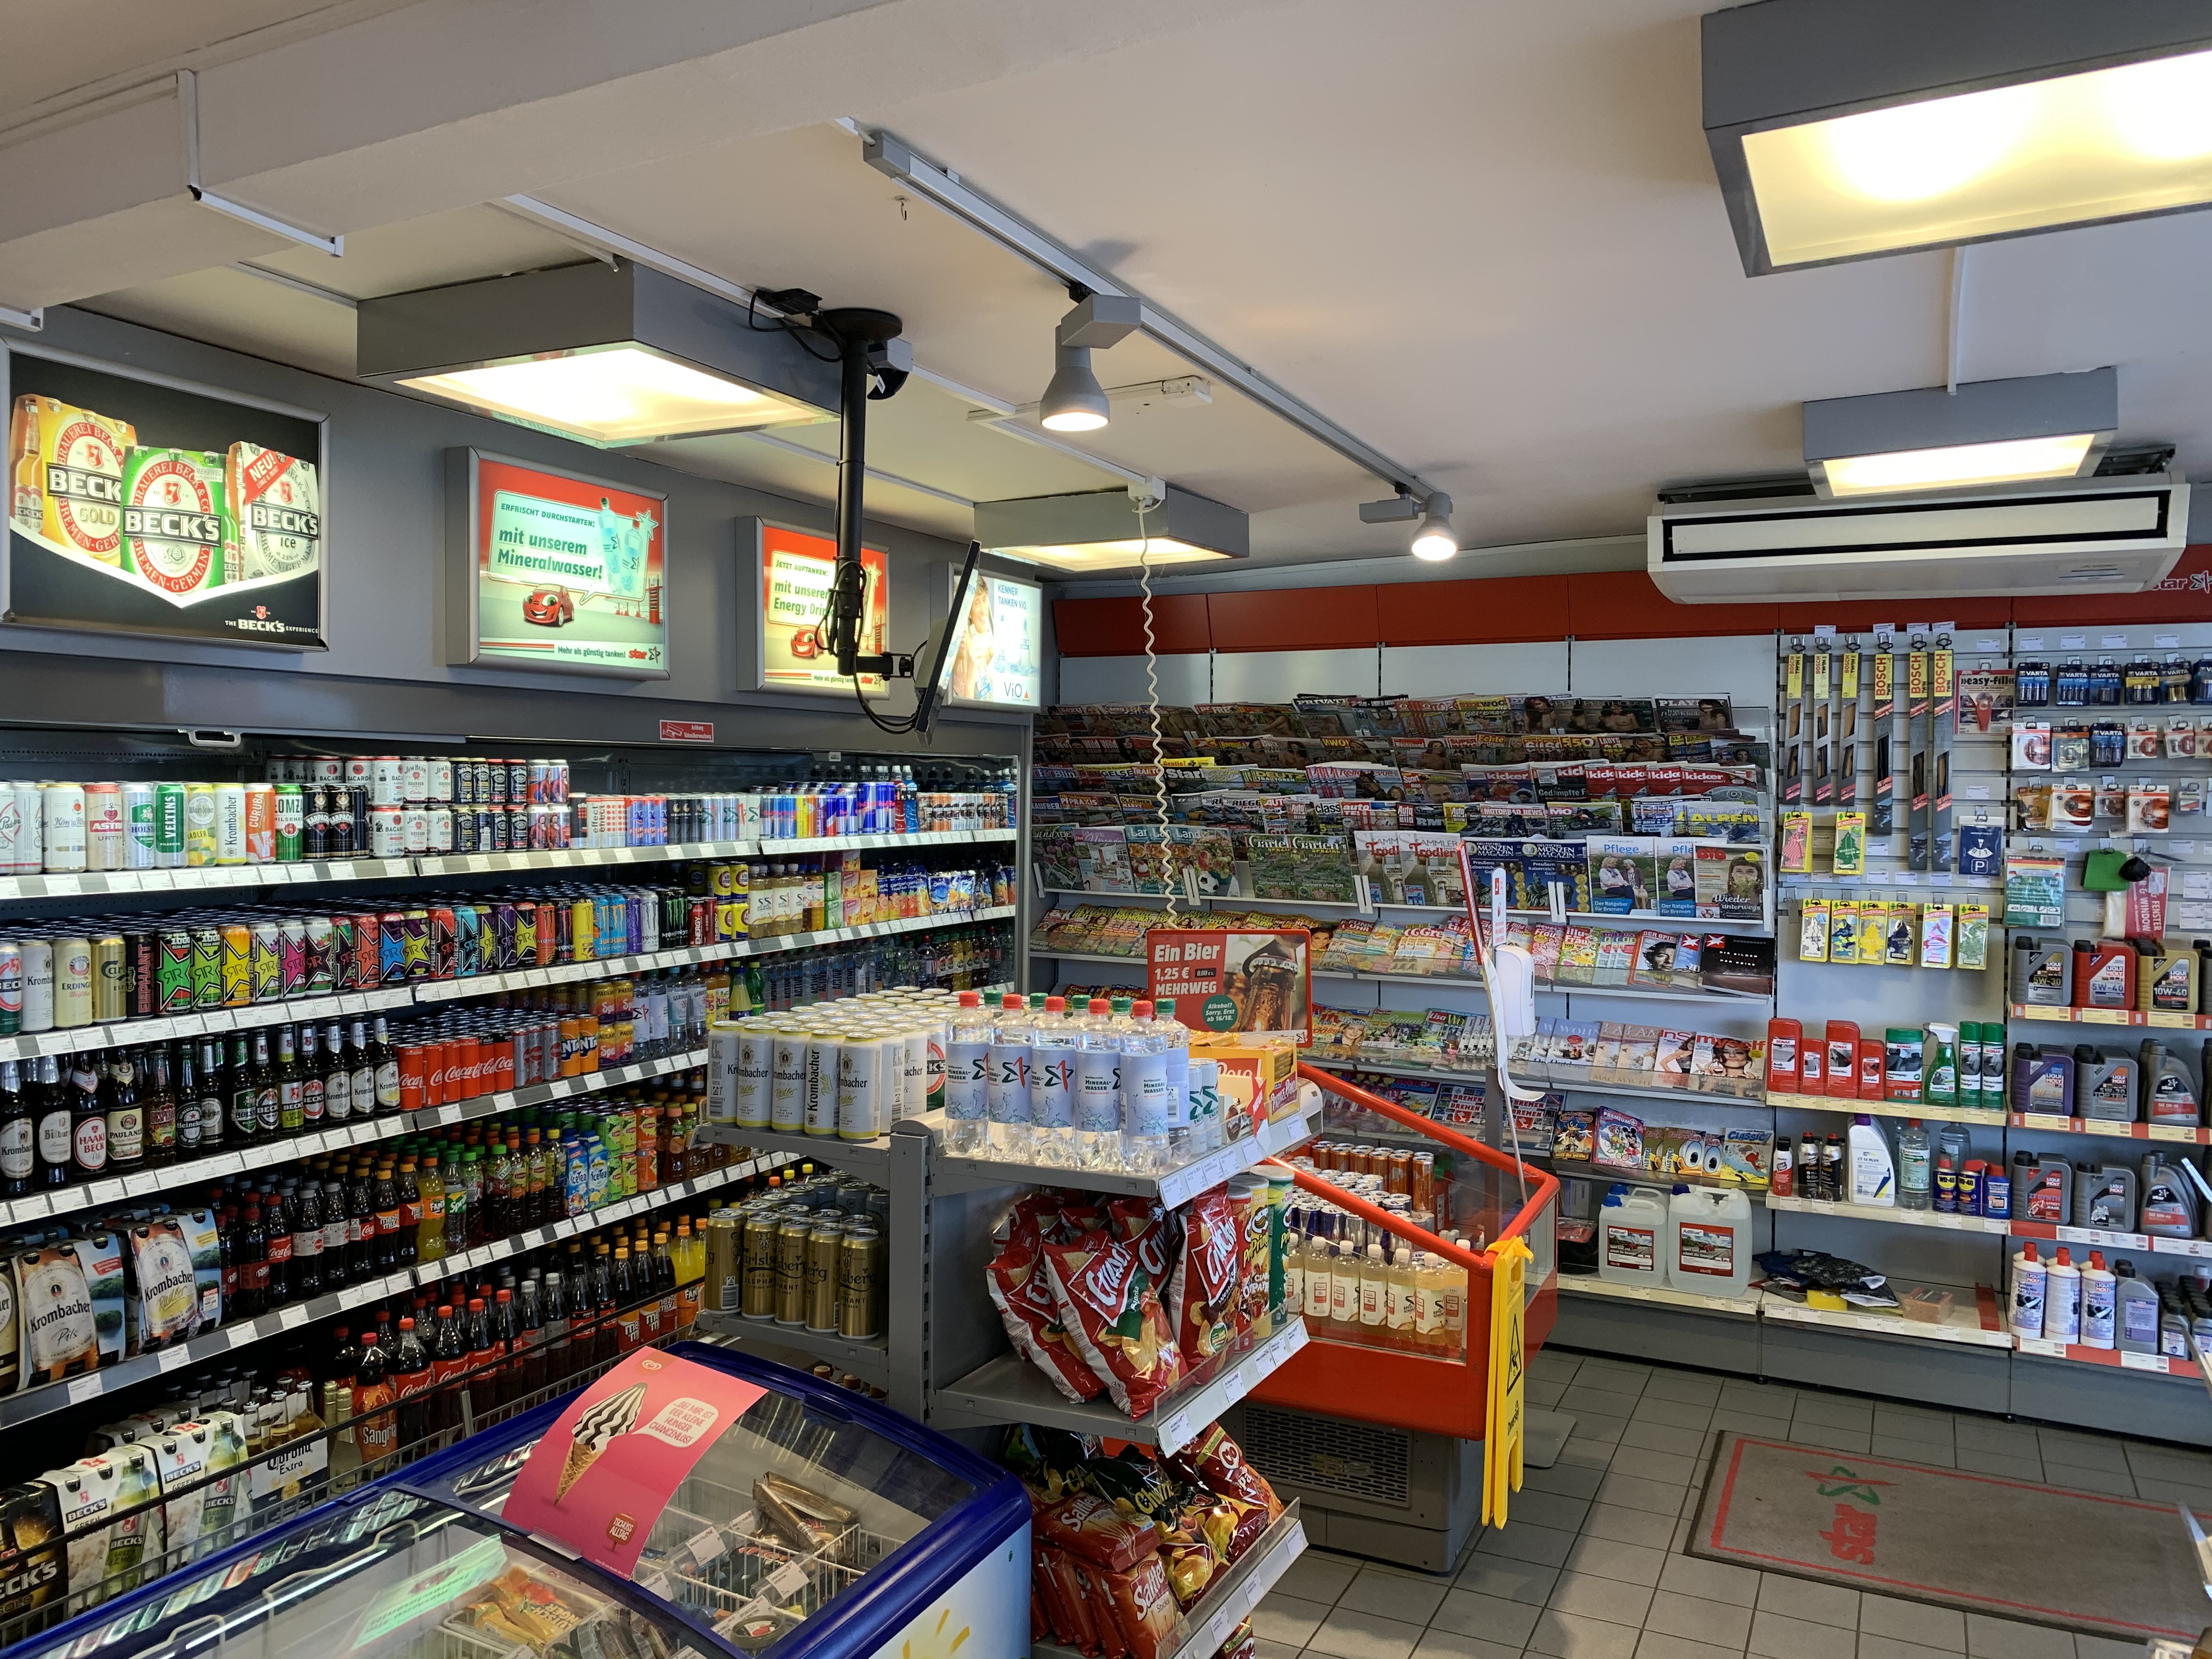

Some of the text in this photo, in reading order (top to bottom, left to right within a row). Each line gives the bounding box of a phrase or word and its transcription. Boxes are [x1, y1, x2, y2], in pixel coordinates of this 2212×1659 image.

[196, 468, 222, 476] MEHRWEG
[249, 452, 276, 482] NEU!
[134, 462, 172, 506] BRAUEREI
[80, 505, 115, 525] GOLD
[252, 506, 318, 536] BECK'S
[501, 503, 595, 528] ERFRISCHT DURCHSTARTEN:
[125, 510, 219, 541] BECK'S
[499, 527, 588, 555] mit unserem
[497, 548, 603, 579] Mineralwasser!
[794, 564, 828, 577] AUFTANKEN:
[774, 580, 791, 593] mit
[998, 584, 1018, 596] KENNER
[774, 597, 806, 616] Energy
[998, 596, 1018, 608] TANKEN
[238, 618, 285, 633] BECK'S
[557, 646, 626, 659] Mehr als günstig tanken!
[628, 648, 647, 660] star
[860, 676, 873, 685] star
[1876, 657, 1886, 696] BOSCH
[1910, 654, 1921, 695] BOSCH
[1935, 653, 1945, 693] BOSCH
[404, 766, 414, 774] JIM
[1256, 771, 1306, 780] DEUTZ
[1486, 771, 1528, 780] kicker
[1685, 772, 1725, 780] kicker
[1069, 797, 1098, 806] PRAXIS
[165, 795, 176, 839] VELTINS
[249, 793, 264, 828] CURUBA
[1692, 812, 1758, 823] ALPEN
[225, 795, 238, 846] Krombacher
[1176, 828, 1201, 839] Land
[1292, 836, 1339, 850] Garten
[1409, 842, 1457, 858] Trödler
[1477, 844, 1514, 852] MÜNZEN
[1537, 845, 1575, 854] MÜNZEN
[1604, 844, 1639, 856] Pflege
[1975, 860, 1985, 872] P
[1713, 894, 1751, 903] Wieder
[2139, 897, 2151, 932] WINDOW
[2151, 900, 2162, 931] FENSTER
[1348, 919, 1374, 928] FUNK
[1349, 923, 1370, 932] UHR
[1536, 928, 1557, 938] Frau
[1565, 933, 1588, 945] Frau
[1154, 943, 1220, 962] Ein Bier
[138, 944, 151, 1013] ELEPHANT
[832, 968, 842, 990] ACTIVE
[1154, 967, 1190, 982] 1,25 €
[2033, 977, 2062, 985] 5W-30
[1155, 981, 1217, 996] MEHRWEG
[2154, 988, 2187, 996] 10W-40
[1430, 1011, 1447, 1021] Lisa
[1696, 1034, 1766, 1051] myself
[807, 1048, 820, 1111] Krombacher
[1451, 1102, 1481, 1111] BREMEN
[1514, 1099, 1544, 1108] BREMEN
[1512, 1108, 1543, 1117] BREMEN
[1603, 1111, 1631, 1124] PREMIUM
[84, 1143, 105, 1154] BECK
[144, 1271, 193, 1303] Krombacher
[156, 1285, 188, 1312] Radler
[1130, 1285, 1141, 1311] Paprika
[30, 1299, 92, 1334] Krombacher
[51, 1328, 78, 1346] Pils
[668, 1408, 706, 1427] DER KLEINE
[688, 1405, 704, 1415] MIR
[702, 1410, 715, 1419] IST
[648, 1421, 693, 1444] CHANCENLOS!
[664, 1417, 692, 1433] HUNGER
[363, 1426, 397, 1447] Sangria
[165, 1461, 201, 1482] BECK'S
[279, 1460, 303, 1476] Extra
[66, 1499, 107, 1523] BECK'S
[613, 1517, 634, 1533] TSCHÜSS
[609, 1526, 629, 1541] ALLTAG
[1818, 1503, 1878, 1565] star
[1155, 1596, 1171, 1614] Sticks
